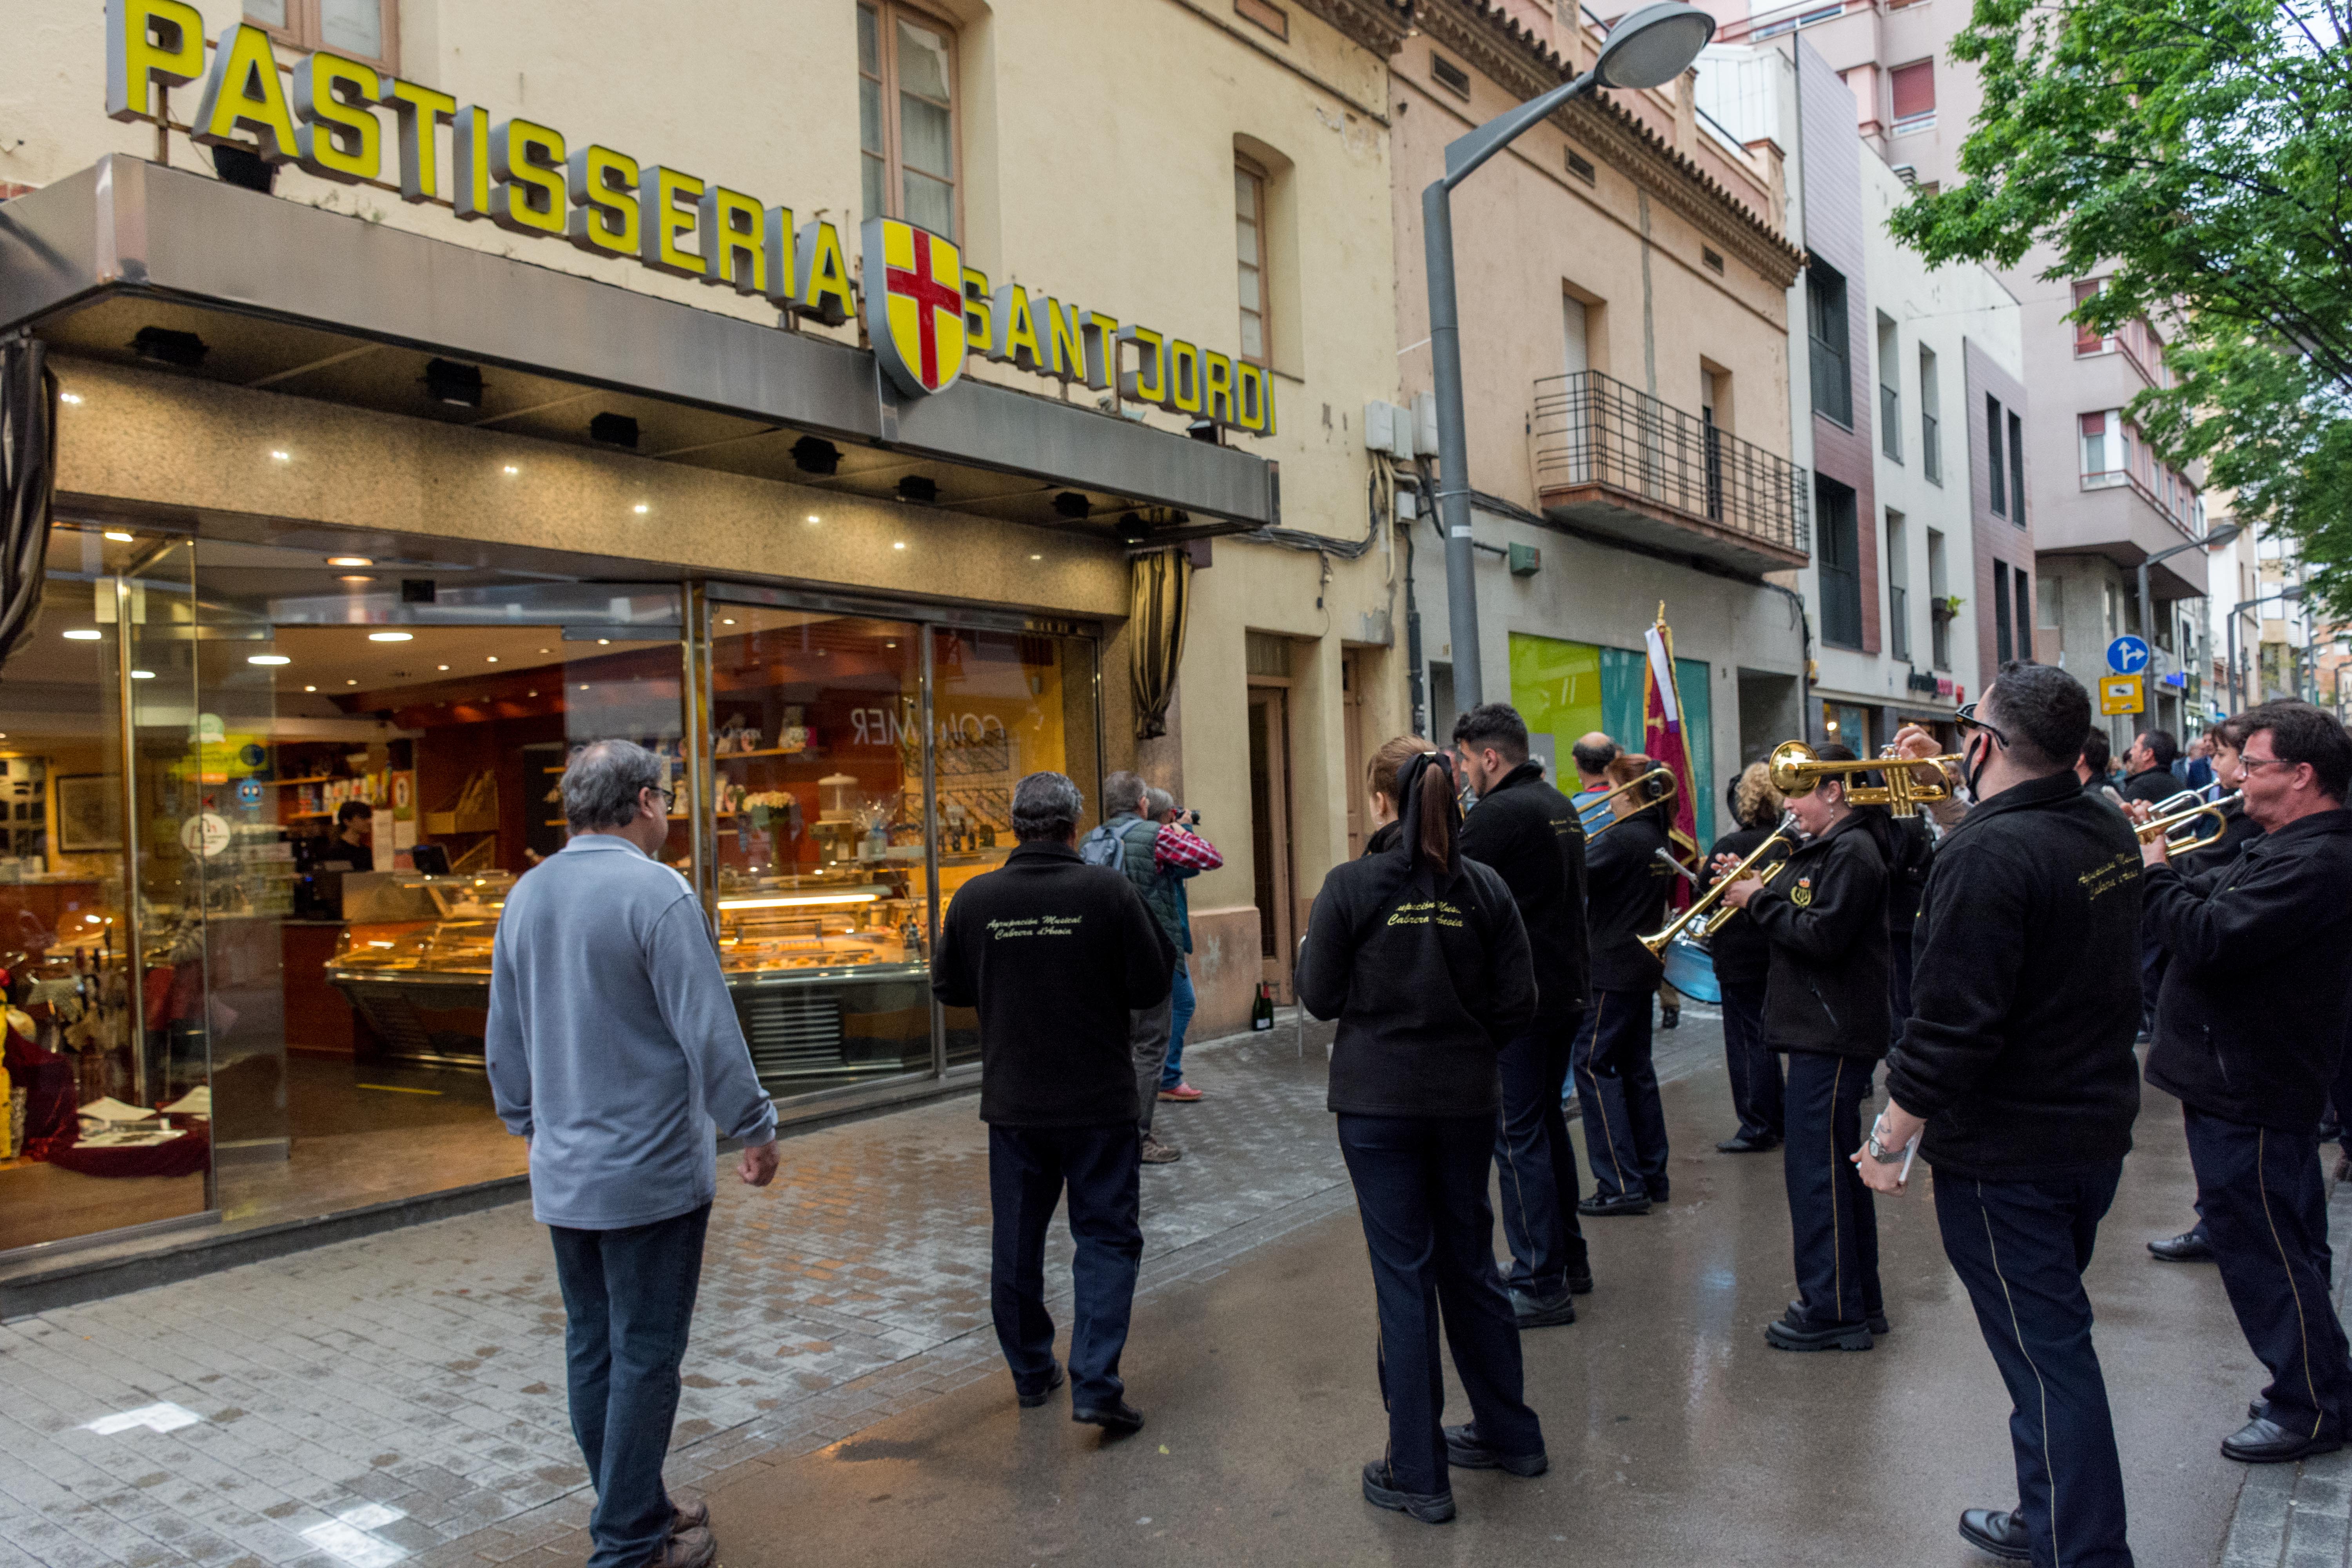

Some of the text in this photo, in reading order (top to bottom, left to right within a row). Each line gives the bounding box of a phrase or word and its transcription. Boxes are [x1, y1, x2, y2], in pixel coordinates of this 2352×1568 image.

[114, 0, 1277, 436] PASTISSERIA SANT JORDI
[1387, 913, 1430, 926] Cabrera
